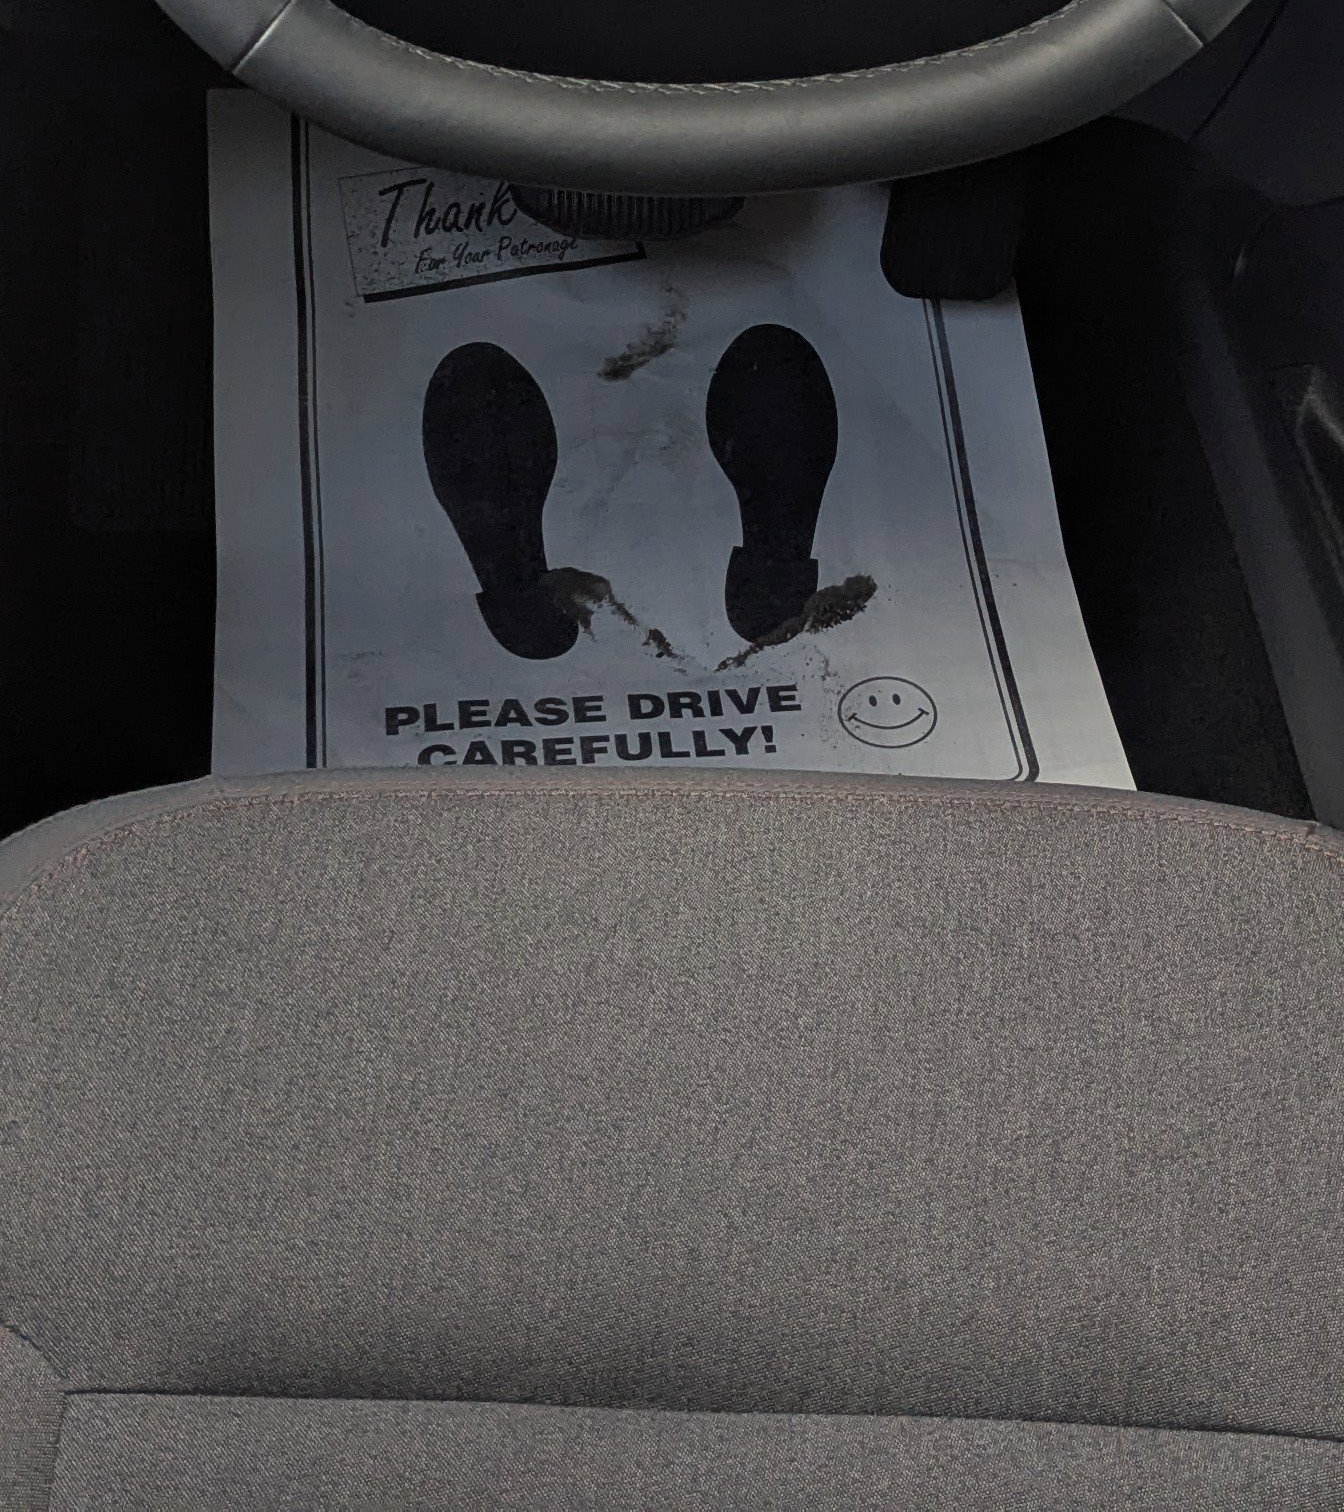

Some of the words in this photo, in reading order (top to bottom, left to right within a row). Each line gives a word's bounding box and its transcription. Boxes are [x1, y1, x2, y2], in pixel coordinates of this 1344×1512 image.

[379, 178, 519, 248] Thank
[414, 248, 446, 275] For
[452, 240, 491, 268] Your
[496, 234, 579, 262] Patronage
[385, 695, 607, 736] PLEASE
[627, 684, 803, 720] DRIVE
[417, 725, 778, 766] CAREFULLY!
